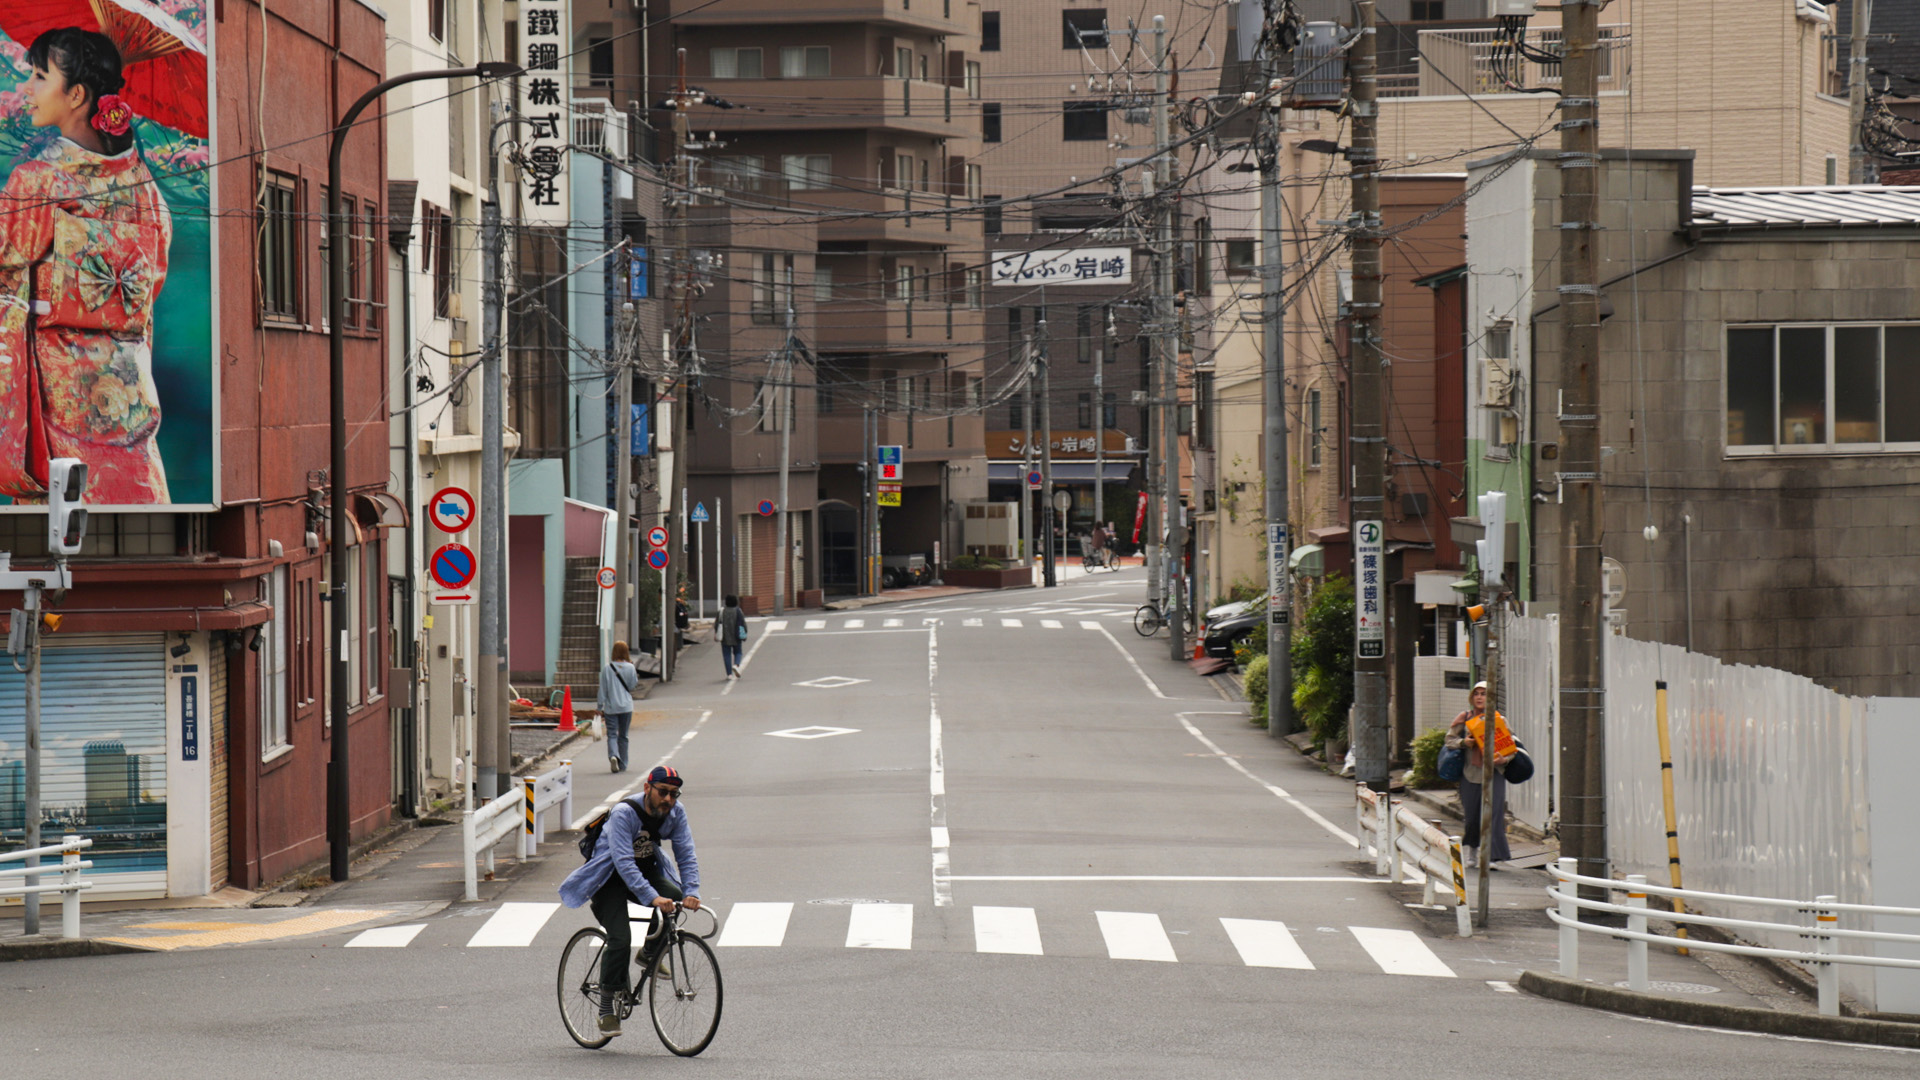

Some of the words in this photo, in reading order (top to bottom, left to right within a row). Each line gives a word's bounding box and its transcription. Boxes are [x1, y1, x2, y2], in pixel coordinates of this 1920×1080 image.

[527, 0, 560, 206] 鐵鋼株式會社
[998, 253, 1124, 283] こんぶの岩崎
[1362, 555, 1378, 615] 篠塚歯科
[184, 746, 196, 756] 16
